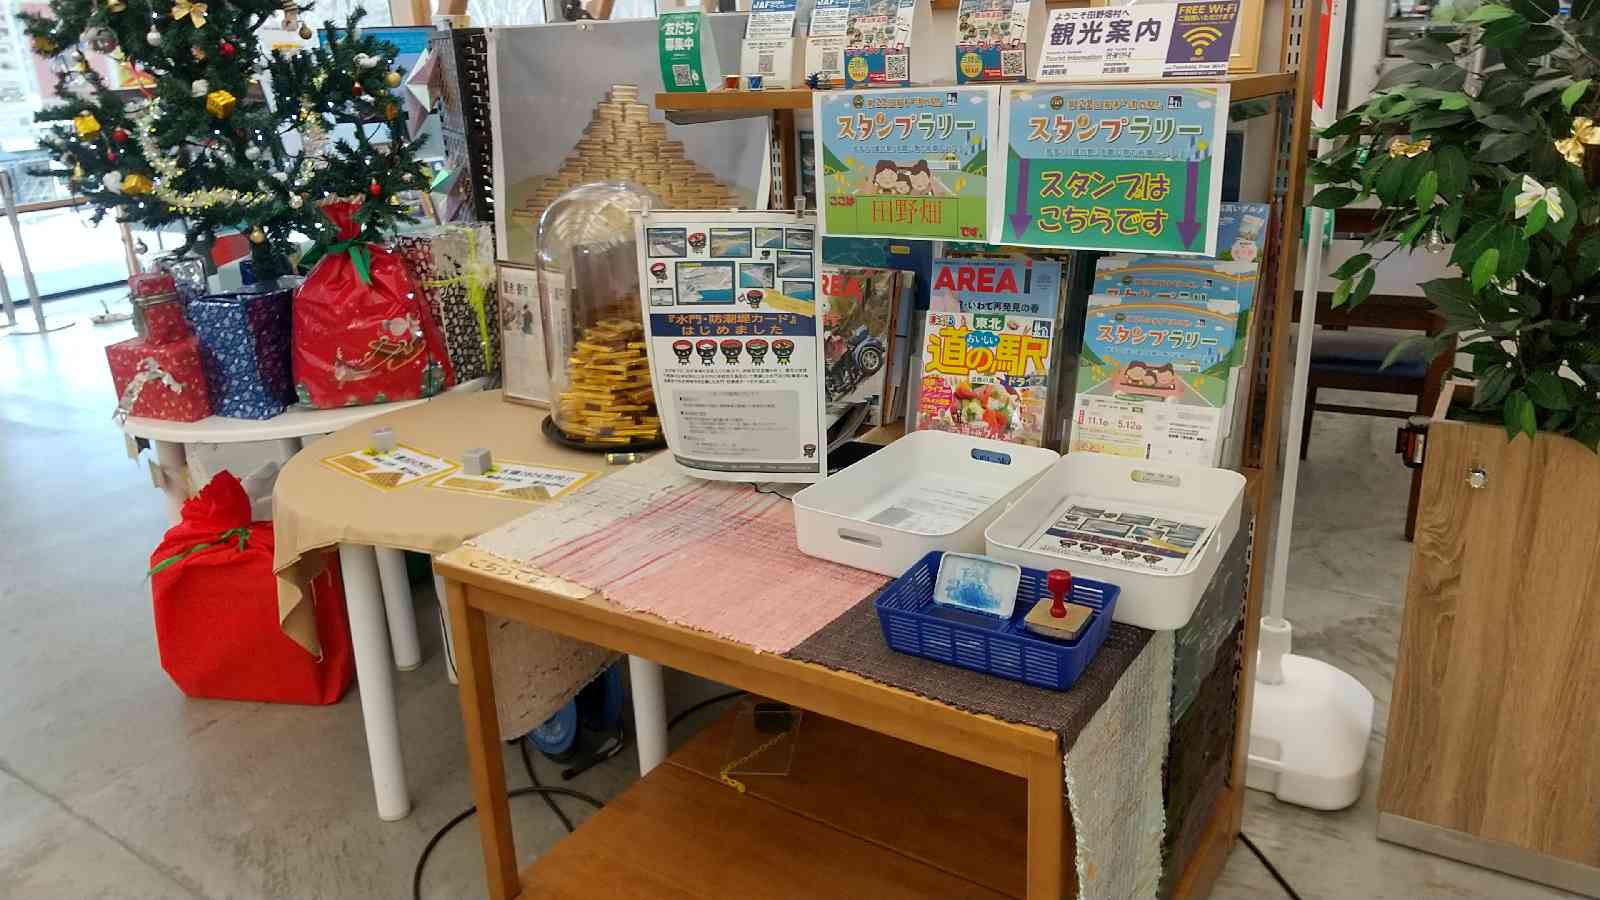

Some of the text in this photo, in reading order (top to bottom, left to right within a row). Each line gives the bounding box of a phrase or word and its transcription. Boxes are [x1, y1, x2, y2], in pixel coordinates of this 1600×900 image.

[1179, 5, 1207, 15] FREE
[1050, 18, 1163, 46] 観光案内
[836, 111, 977, 142] スタンプラリー
[1027, 114, 1204, 145] スタンプラリー
[1039, 170, 1171, 201] スタンプは
[871, 198, 945, 226] 田野畑
[1038, 204, 1169, 237] こちらです
[932, 265, 1020, 295] AREA
[681, 324, 786, 336] はじめました
[974, 316, 1003, 331] 東北
[1097, 324, 1218, 350] スタンプラリー
[925, 326, 1050, 376] 道の駅
